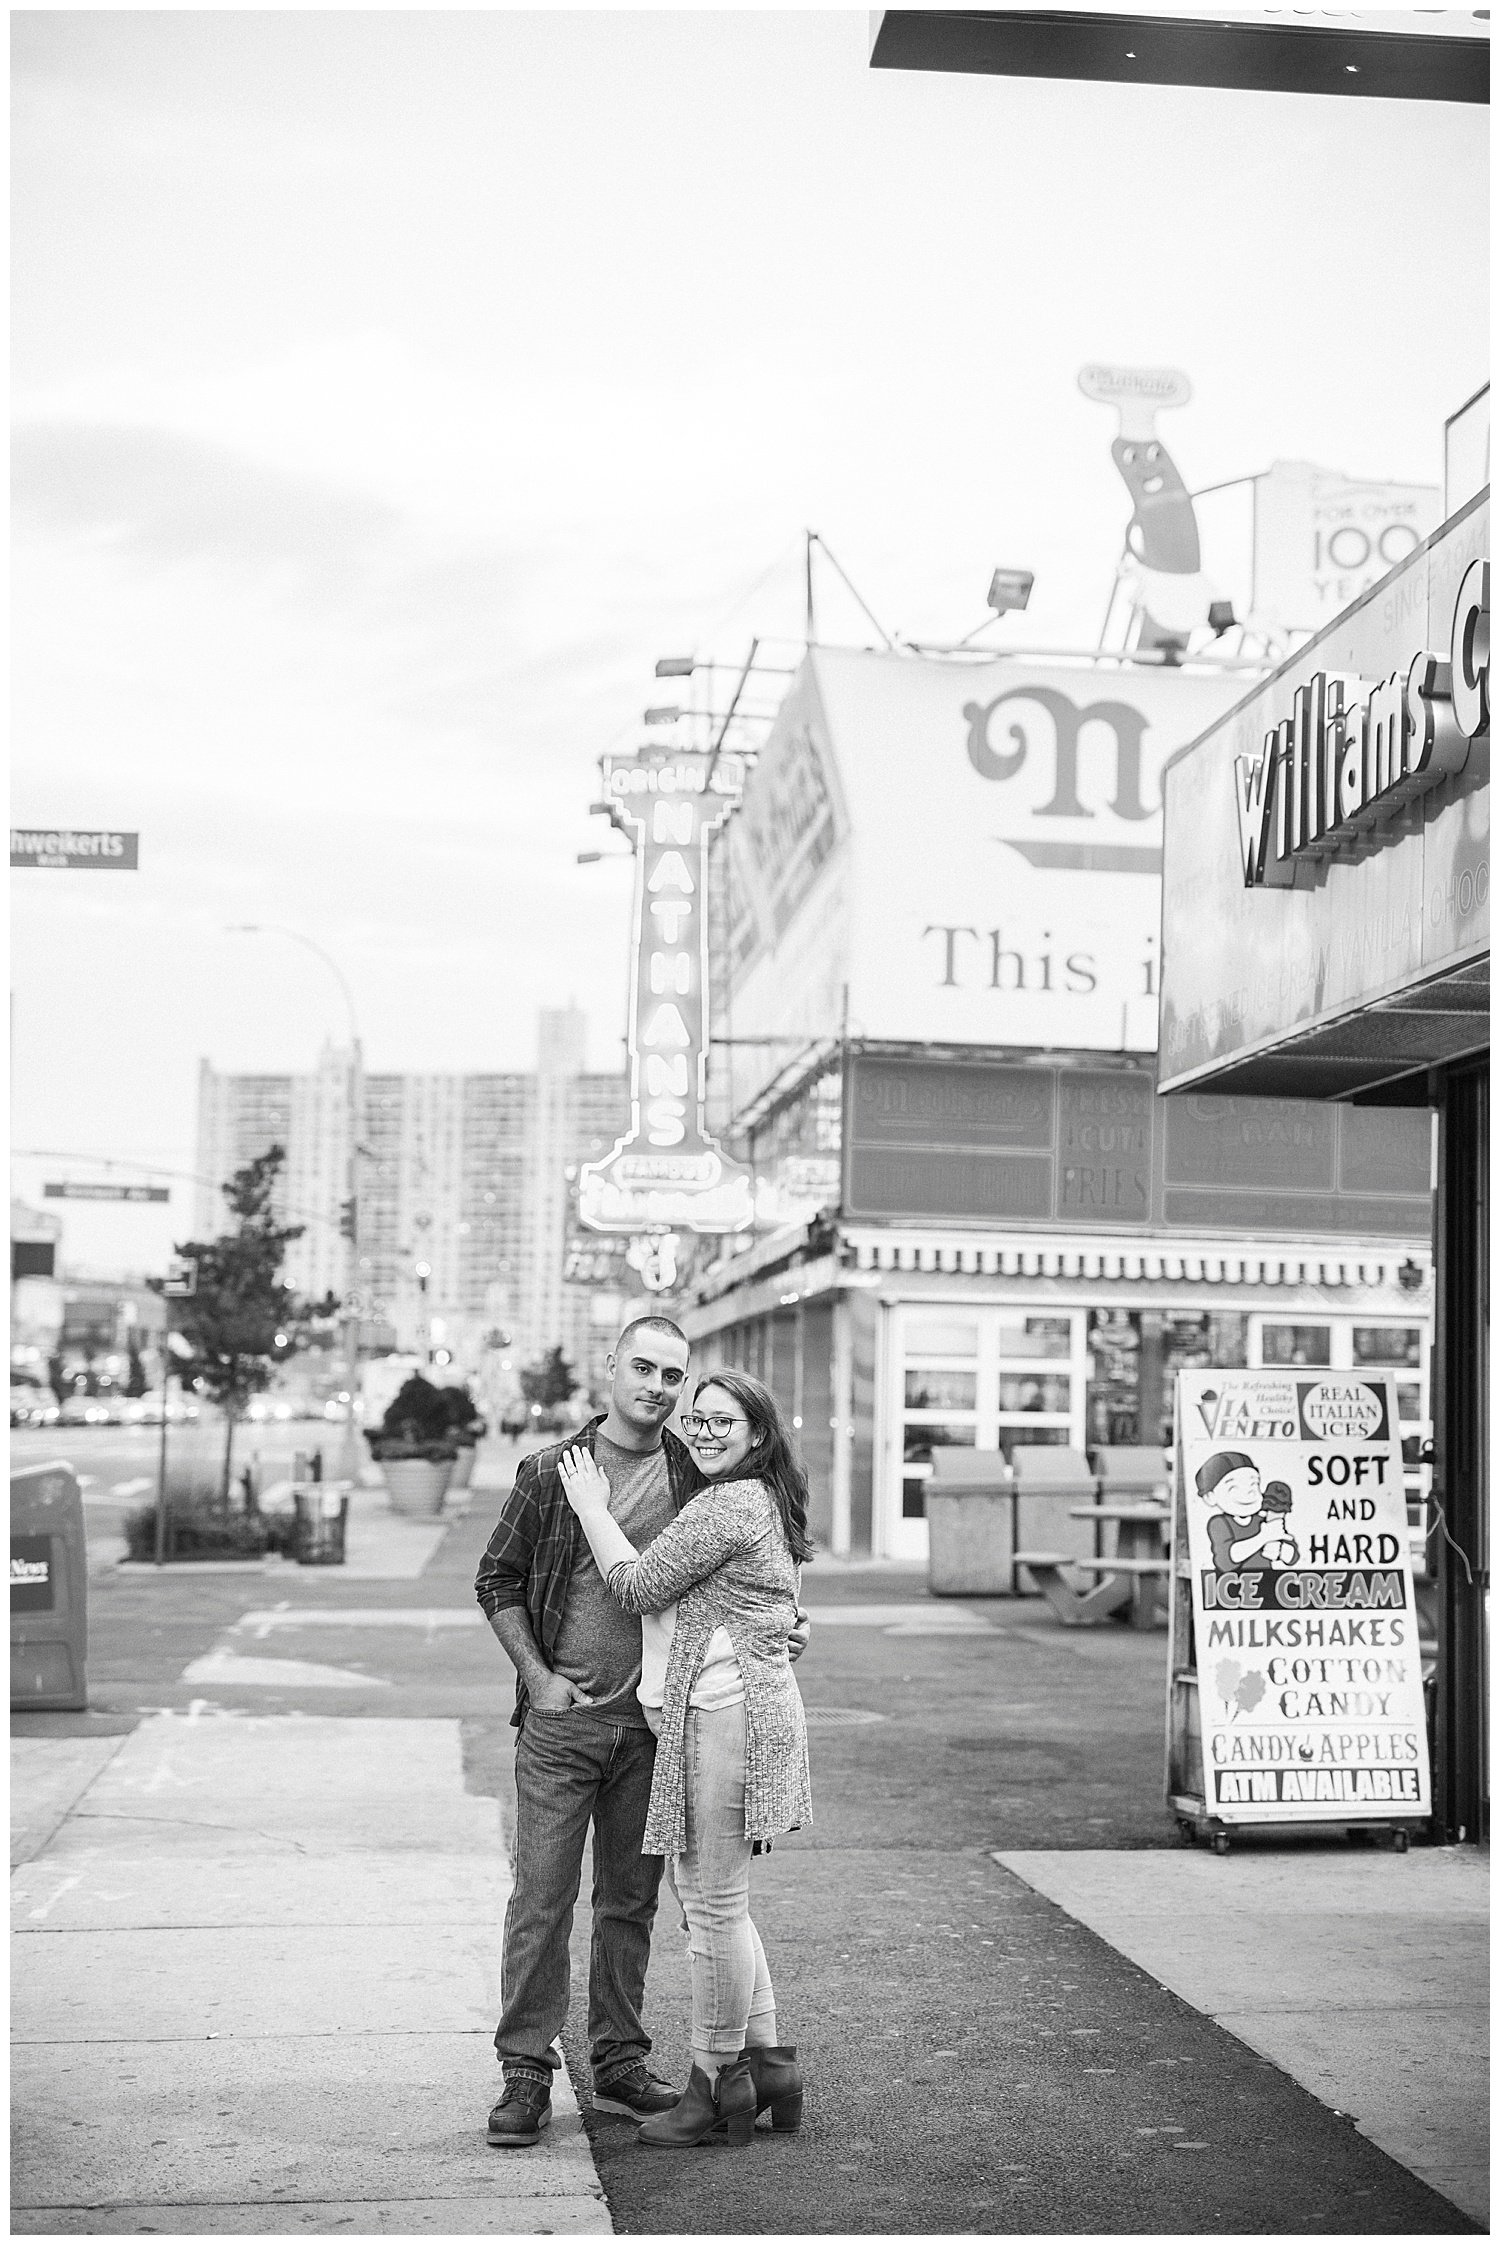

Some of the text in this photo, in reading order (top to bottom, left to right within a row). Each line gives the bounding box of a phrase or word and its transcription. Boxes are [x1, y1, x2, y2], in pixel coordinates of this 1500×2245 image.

[1314, 524, 1420, 570] 100
[1234, 559, 1490, 888] Williams C
[1341, 902, 1413, 972] VANILLA
[1430, 860, 1490, 930] CHOC
[642, 800, 696, 1147] NATHANS
[922, 925, 1097, 995] This
[1080, 1125, 1132, 1152] CUT
[1062, 1165, 1148, 1206] FRIES
[1320, 1387, 1365, 1400] REAL
[1310, 1405, 1378, 1418] ITALIAN
[1322, 1422, 1368, 1436] ICES
[1308, 1455, 1390, 1486] SOFT
[1327, 1498, 1376, 1521] AND
[1309, 1533, 1399, 1564] HARD
[1203, 1571, 1404, 1610] ICE CREAM
[1208, 1618, 1405, 1648] MILKSHAKES
[1267, 1657, 1408, 1686] COTTON
[1279, 1690, 1392, 1719] CANDY
[1211, 1733, 1419, 1765] CANDY APPLES
[1219, 1770, 1419, 1802] ATM AVAILABLE
